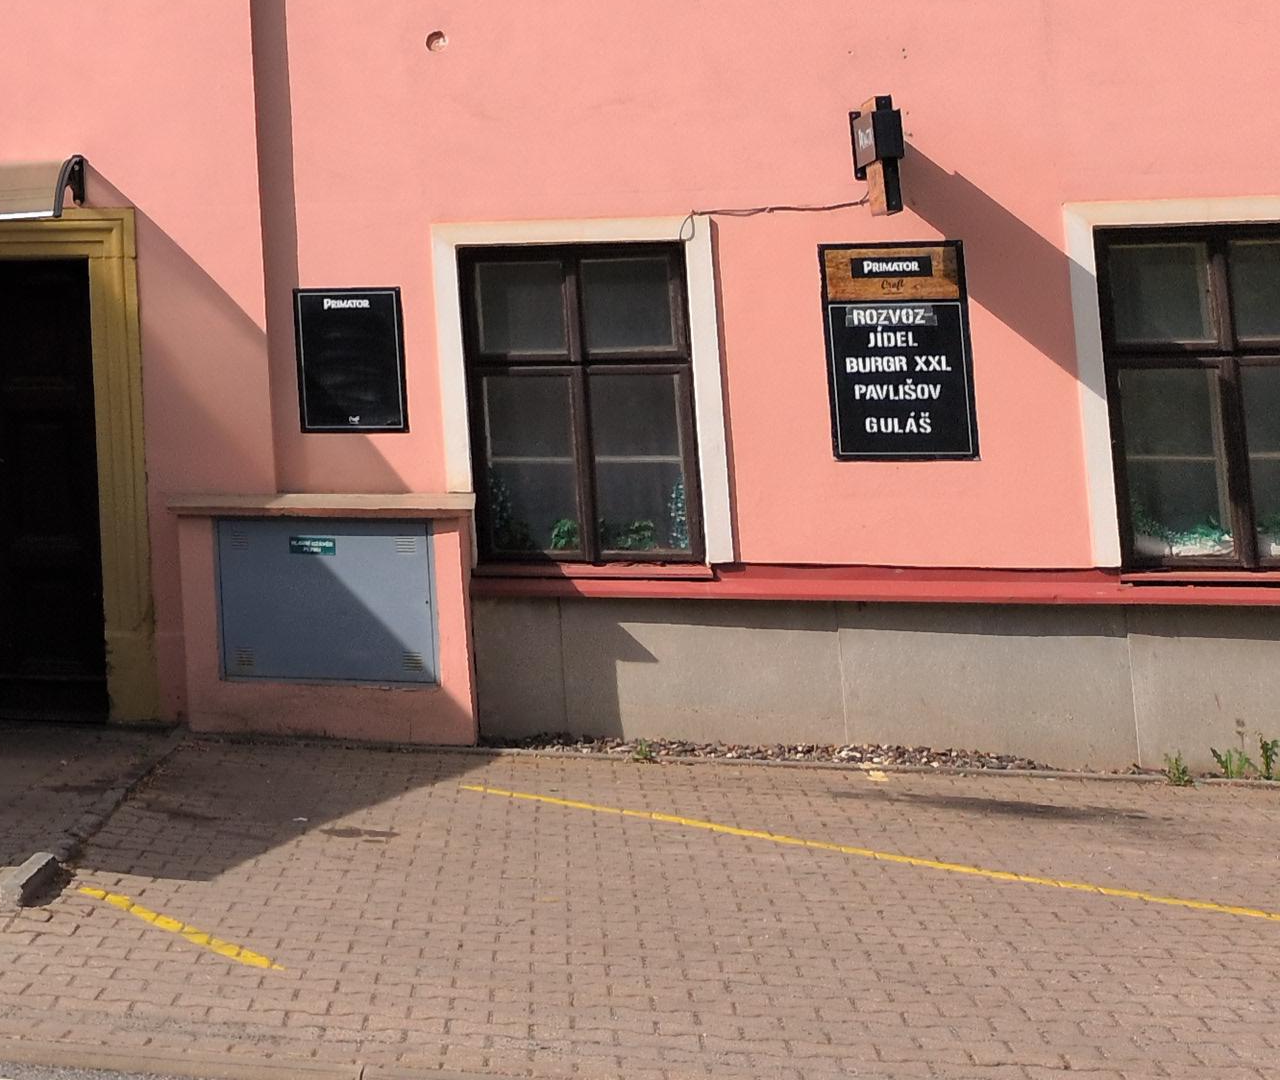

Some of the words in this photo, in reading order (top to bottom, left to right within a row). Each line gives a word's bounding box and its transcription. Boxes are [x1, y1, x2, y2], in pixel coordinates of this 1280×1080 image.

[863, 260, 920, 274] PRIMATOR
[852, 308, 926, 325] ROZVOZ
[867, 325, 918, 348] JÍDEL
[845, 356, 907, 373] BURGR
[914, 355, 952, 371] XXL
[854, 378, 942, 400] PAVLIŠOV
[865, 411, 932, 434] GULÁŠ
